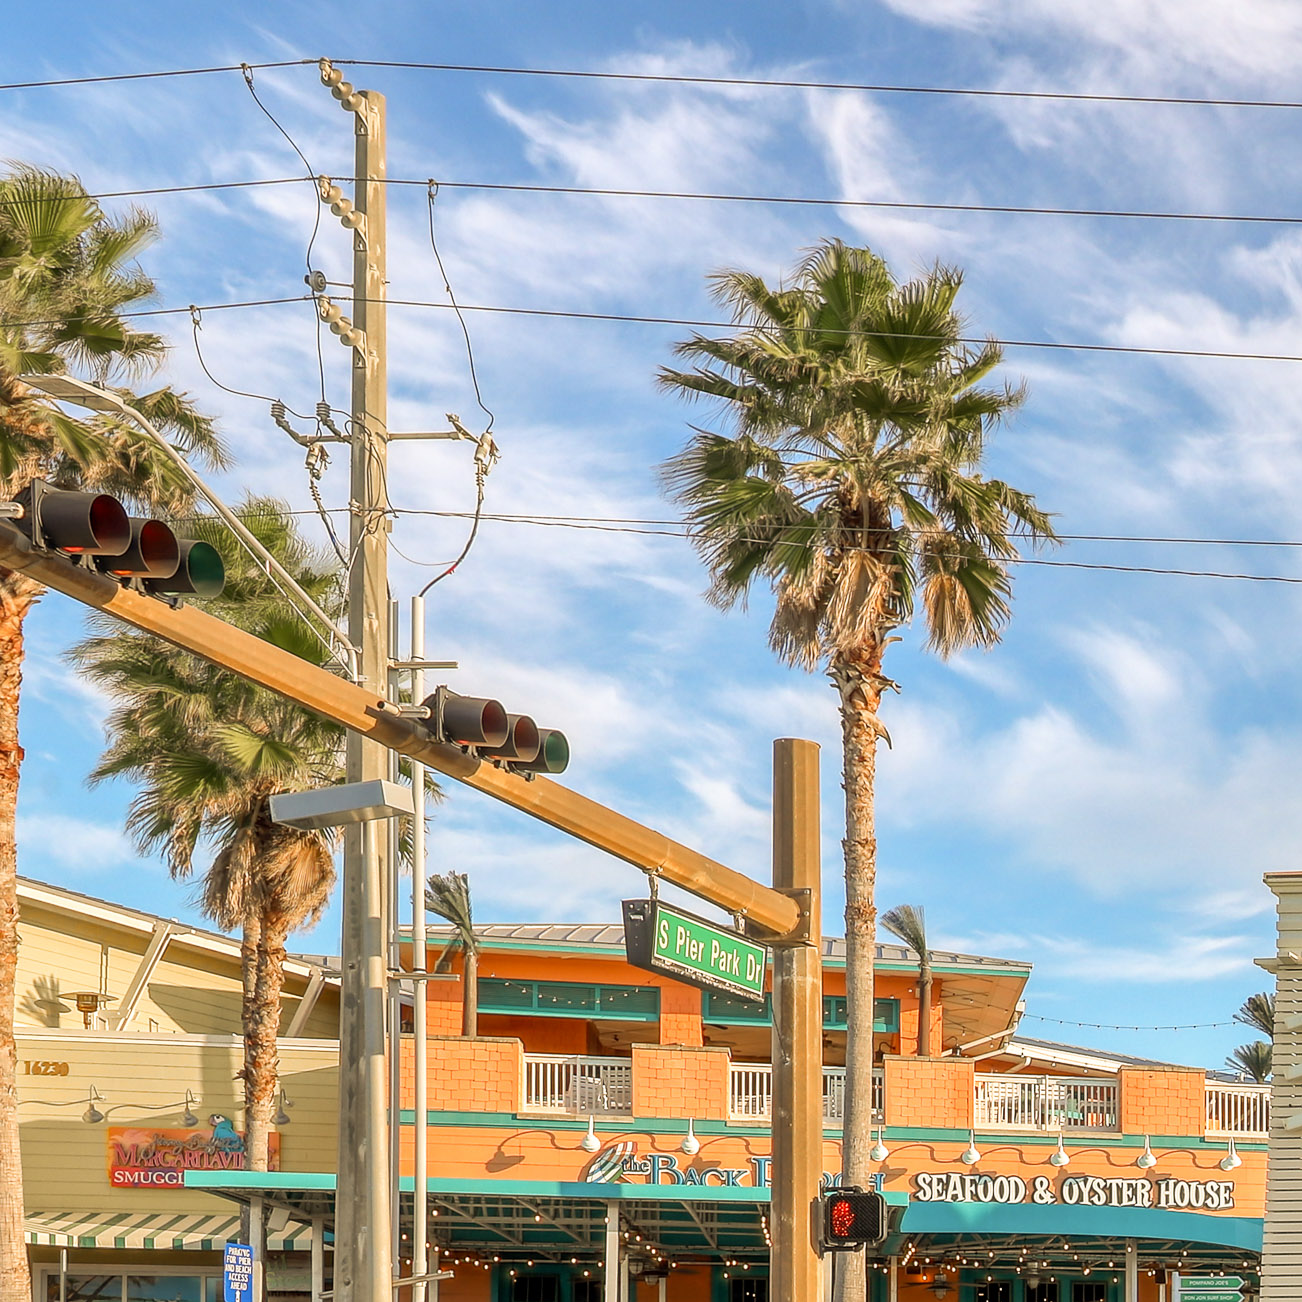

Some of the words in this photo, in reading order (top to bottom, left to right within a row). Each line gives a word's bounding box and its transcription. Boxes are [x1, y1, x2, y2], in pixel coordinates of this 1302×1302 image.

[658, 919, 669, 949] S
[676, 925, 704, 962] Pier
[711, 939, 740, 977] Park
[746, 953, 761, 983] Dr
[24, 1061, 69, 1076] 16230
[621, 1155, 650, 1174] the
[649, 1153, 751, 1187] BACK
[114, 1170, 184, 1184] SMUGGL
[915, 1173, 1026, 1203] SEAFOOD
[1033, 1176, 1056, 1204] &
[1062, 1176, 1153, 1208] OYSTER
[1156, 1179, 1235, 1210] HOUSE
[228, 1247, 250, 1257] PARKING
[226, 1255, 236, 1264] FOR
[238, 1256, 251, 1266] PIER
[225, 1264, 235, 1272] AND
[235, 1265, 252, 1275] BEACH
[228, 1273, 249, 1283] ACCESS
[230, 1282, 248, 1291] AHEAD
